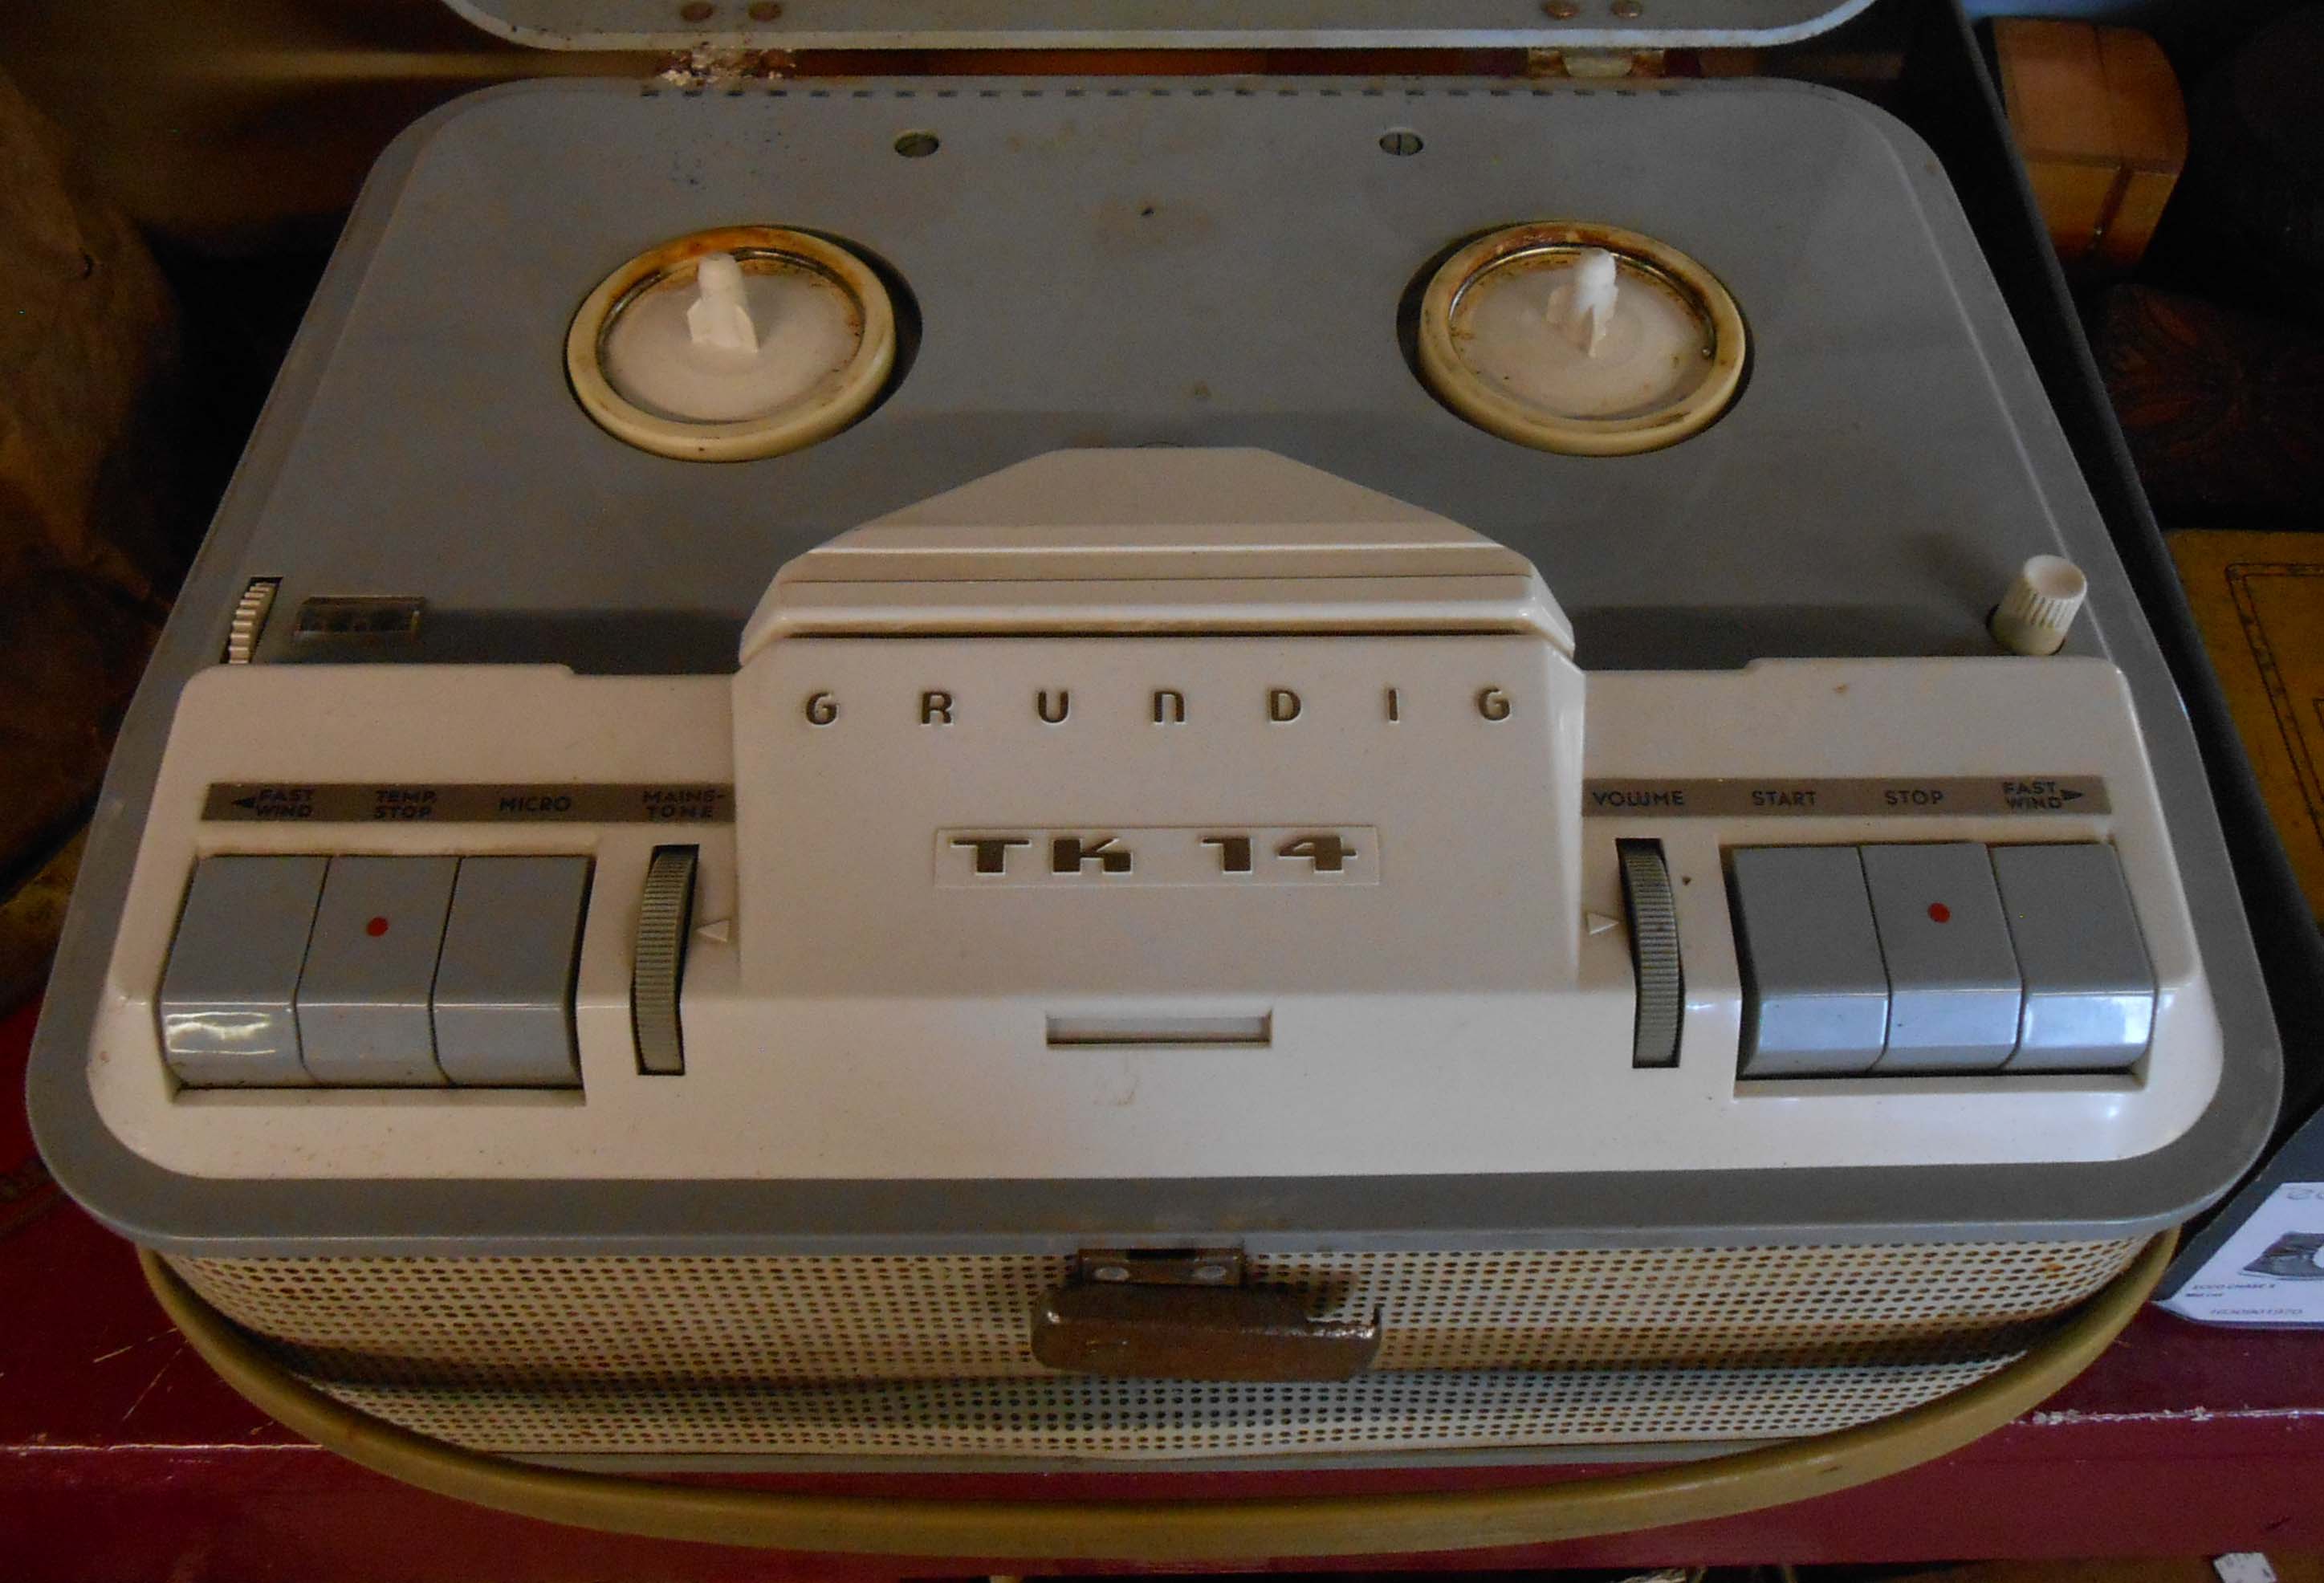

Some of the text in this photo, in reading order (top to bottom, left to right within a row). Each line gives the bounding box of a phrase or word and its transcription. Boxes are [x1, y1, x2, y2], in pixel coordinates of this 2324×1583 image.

[805, 686, 1512, 726] GRUNDIG
[260, 788, 315, 802] FAST
[2003, 781, 2057, 795] FAST
[499, 797, 572, 812] MICRO
[1592, 791, 1684, 806] VOLUME
[1750, 791, 1816, 806] START
[1884, 790, 1943, 805] STOP
[2006, 796, 2062, 809] WIND
[256, 804, 313, 818] WIND
[374, 805, 432, 819] STOP
[645, 805, 714, 819] TONE
[950, 836, 1357, 874] TK 14
